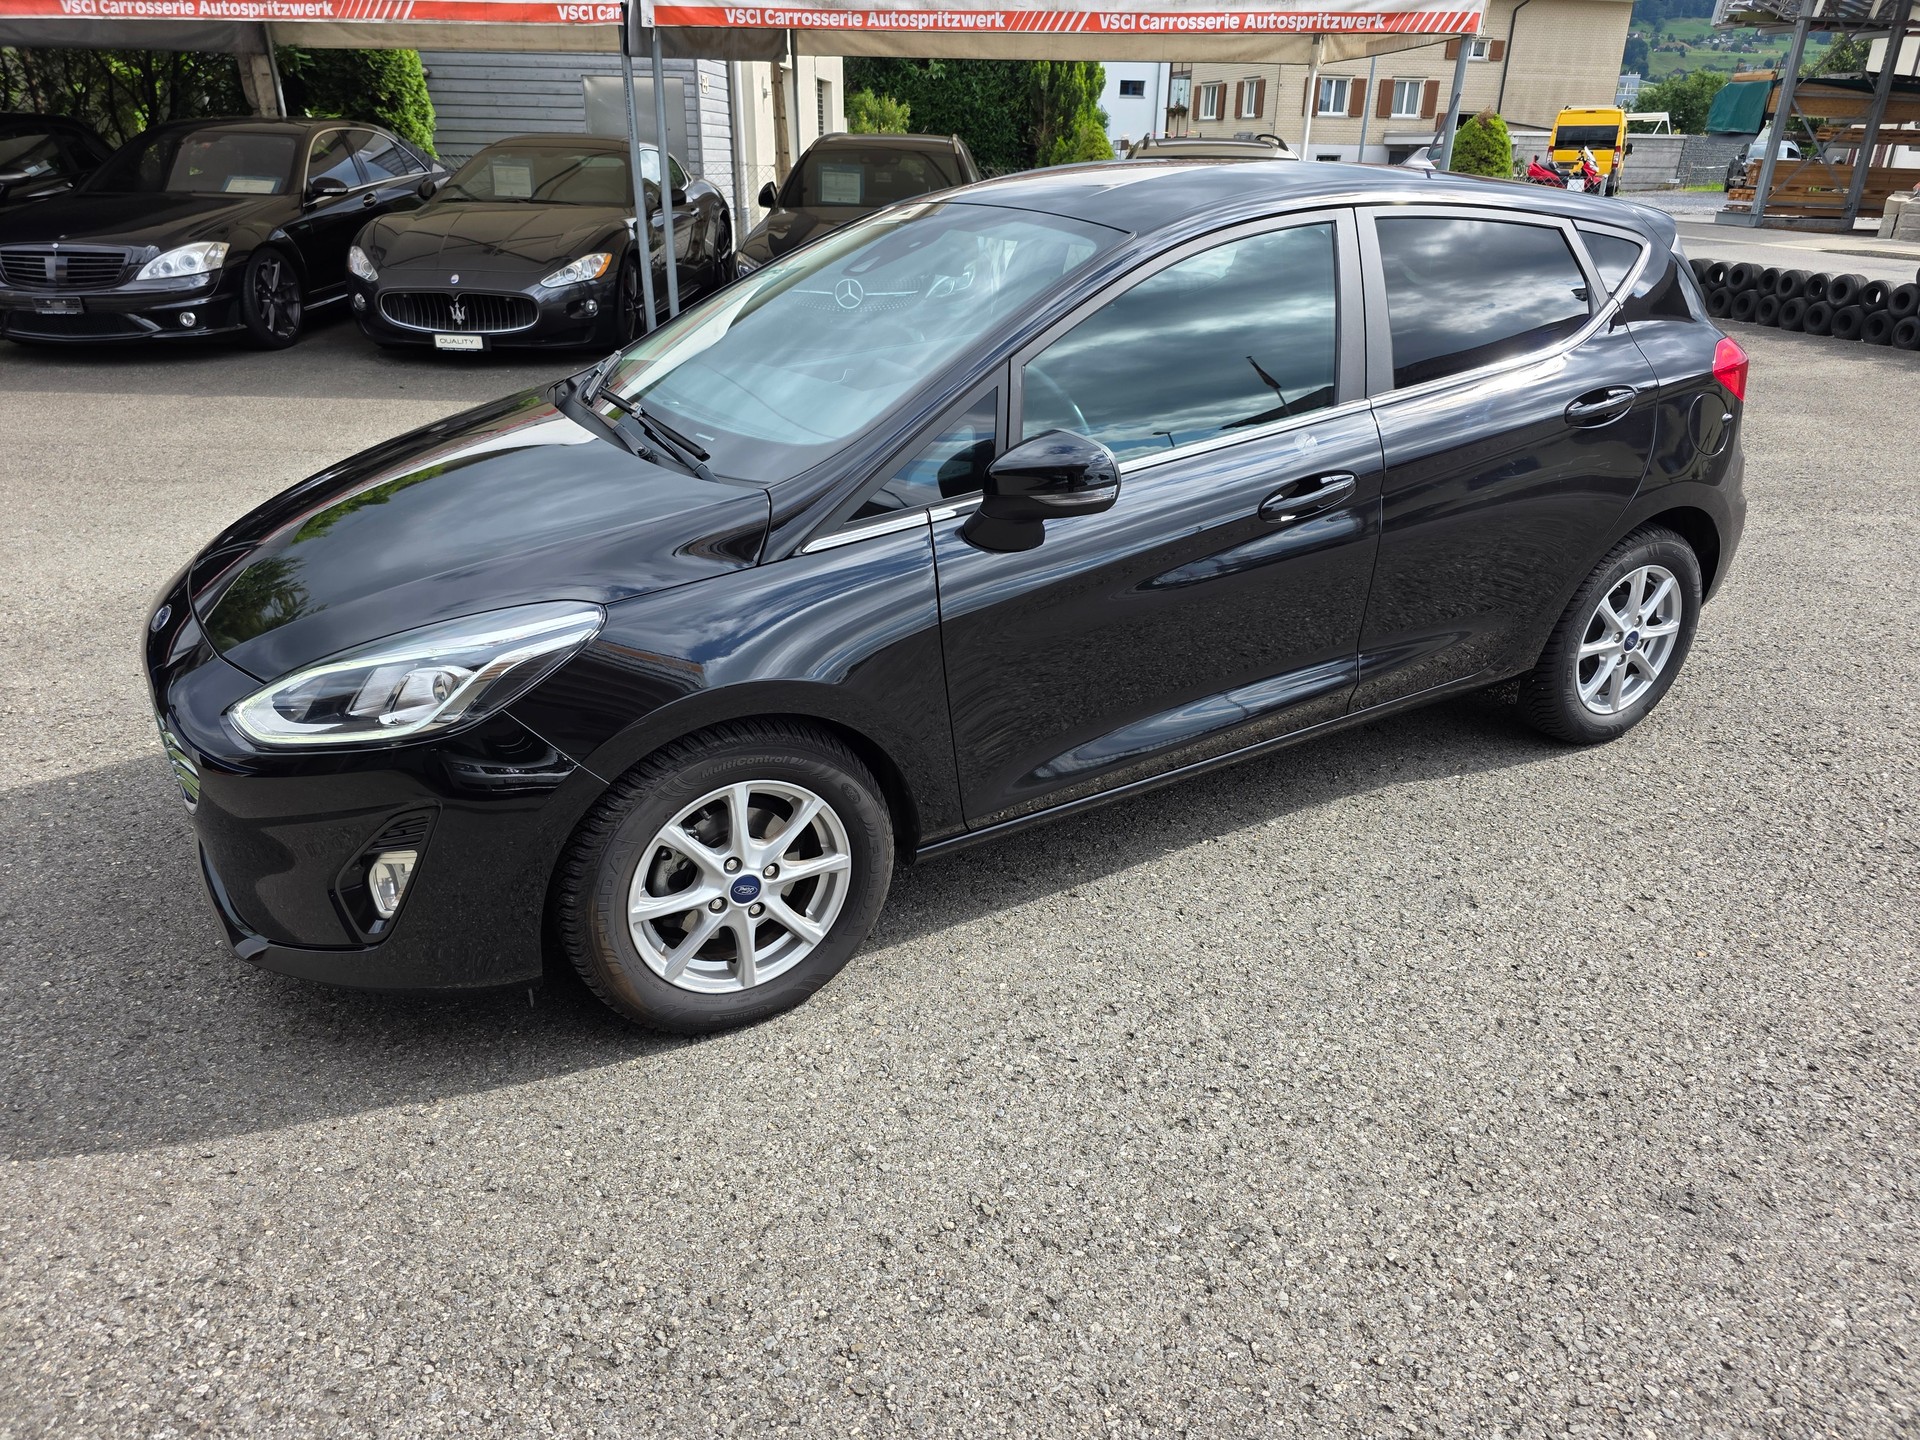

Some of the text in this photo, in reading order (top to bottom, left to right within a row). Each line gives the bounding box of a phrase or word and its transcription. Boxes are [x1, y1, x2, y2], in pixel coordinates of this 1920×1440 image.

[61, 0, 334, 17] VSCI Carrosserie Autospritzwerk
[557, 5, 594, 20] VSCI
[725, 8, 1006, 29] VSCI Carrosserie Autospritzwerk
[1099, 13, 1386, 32] VSCI Carrosserie Autospritzwerk
[701, 755, 788, 778] MultiControl
